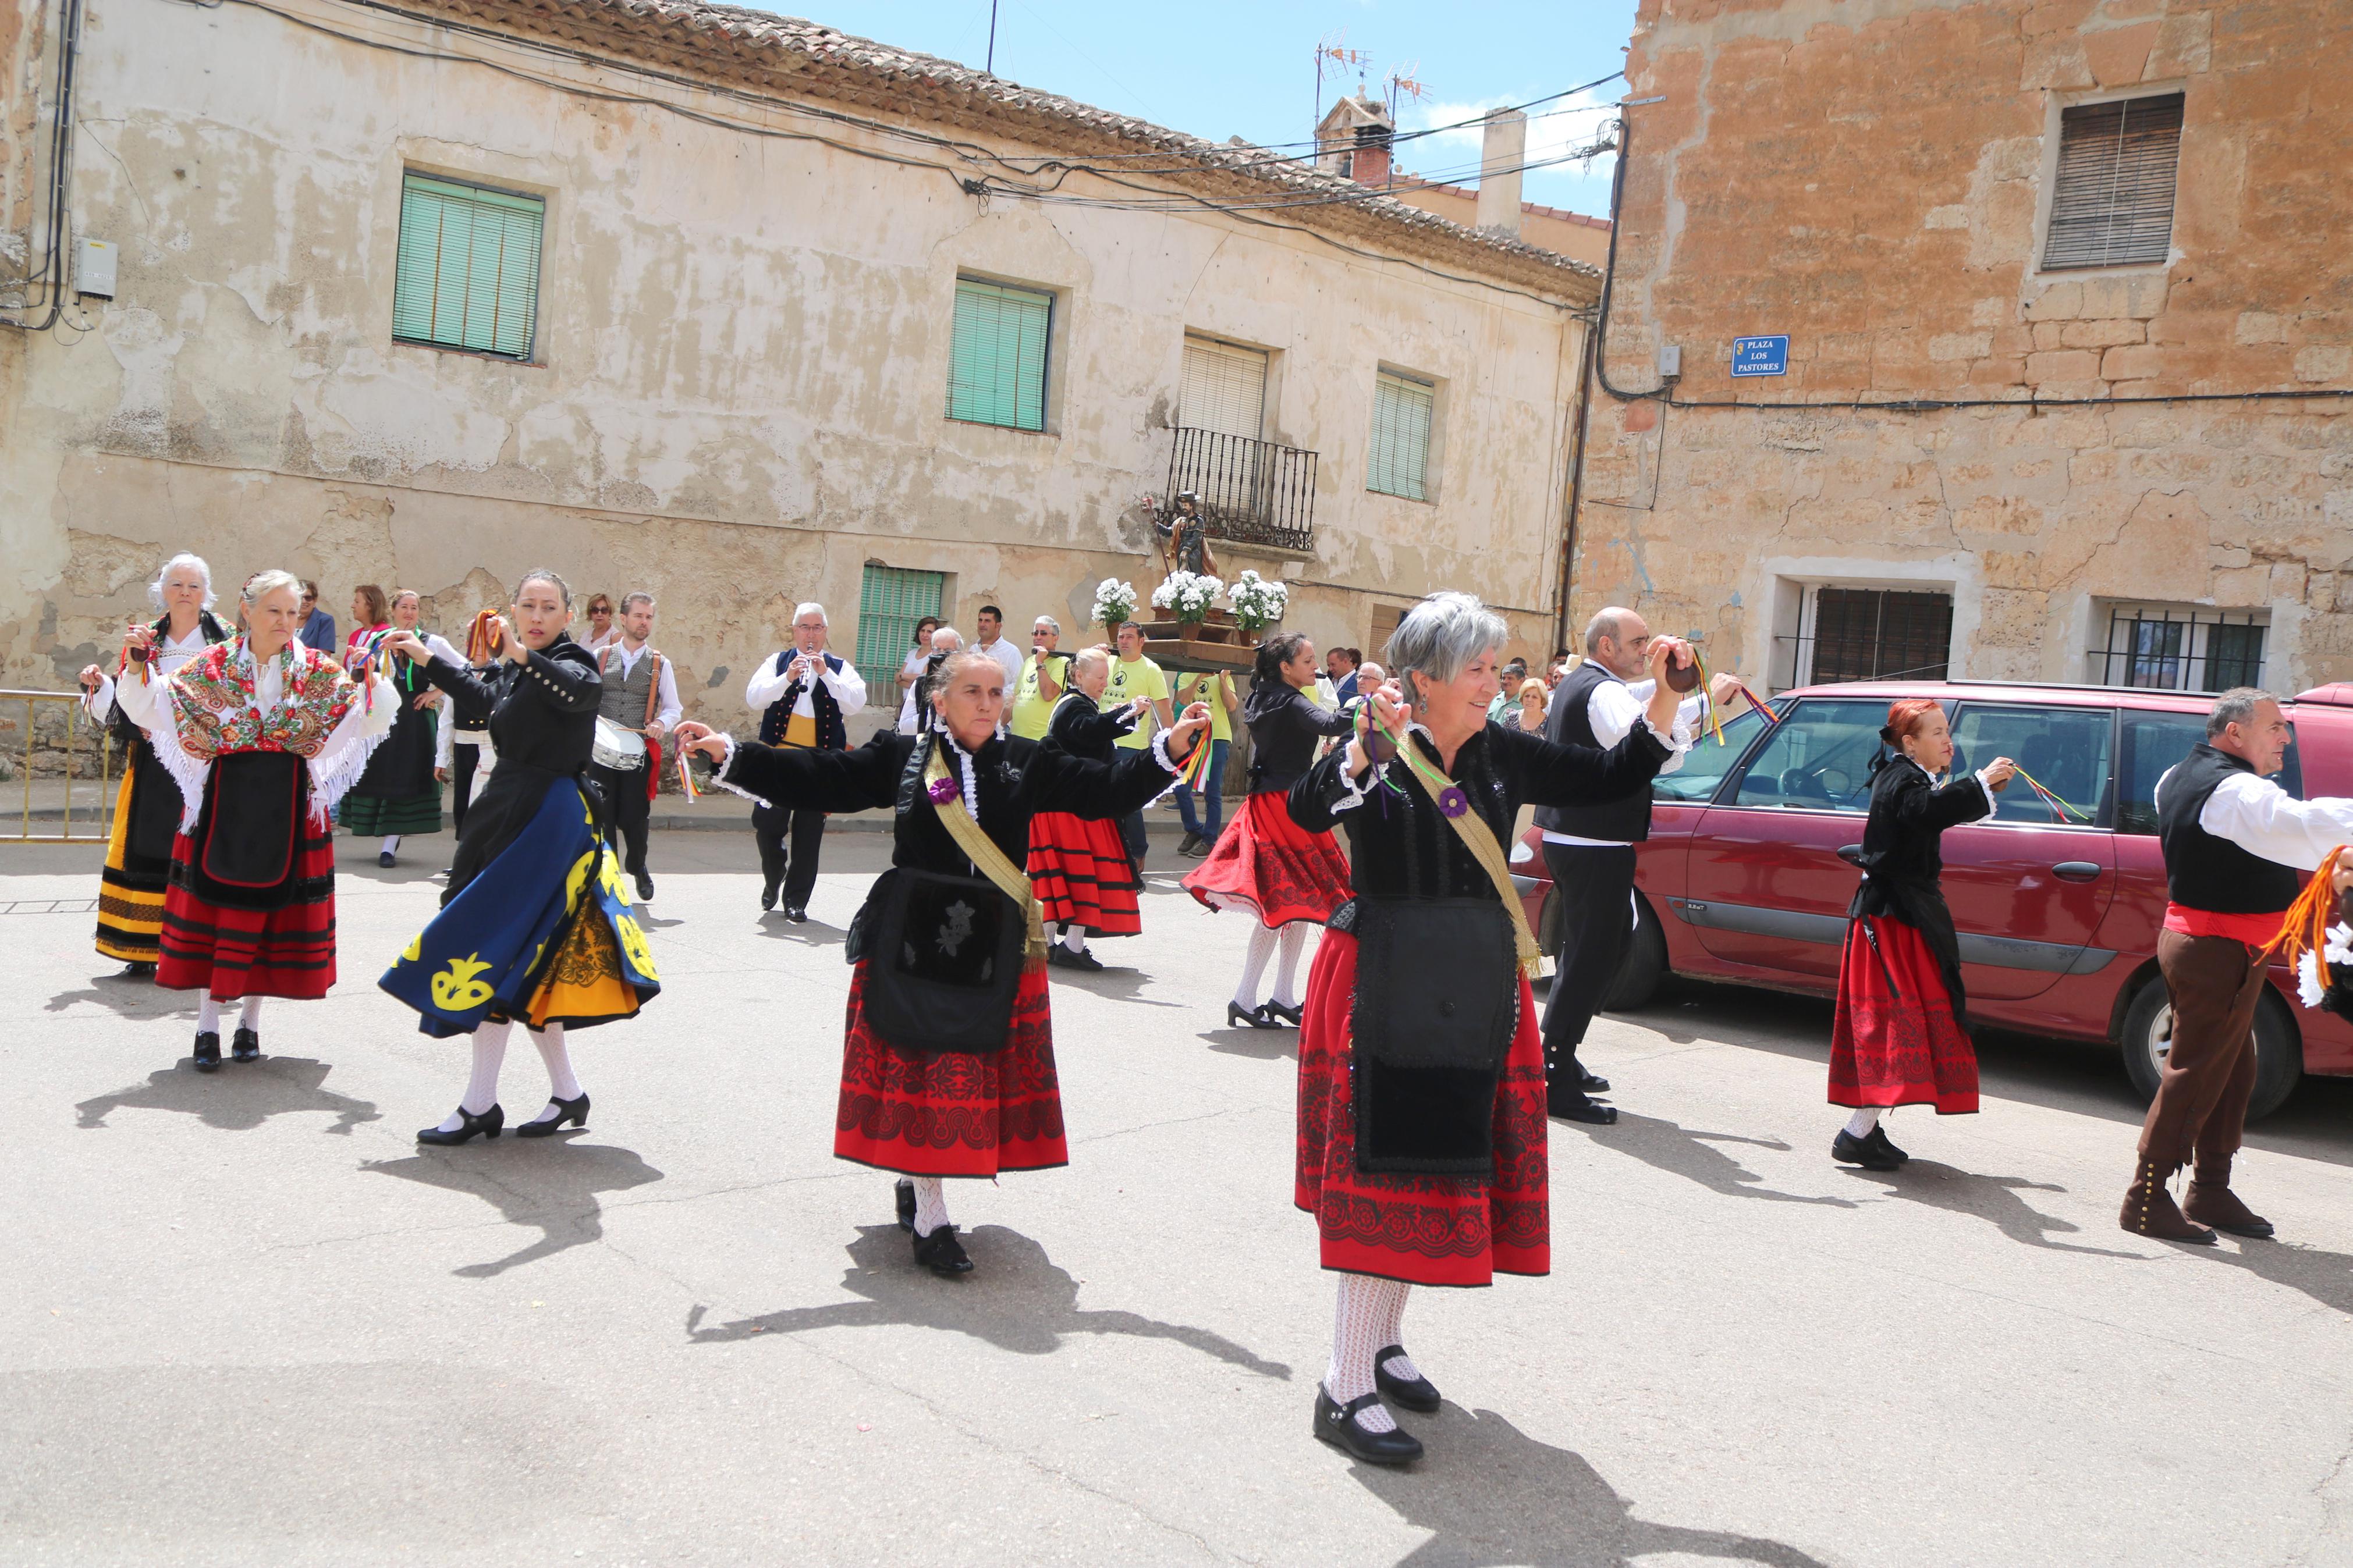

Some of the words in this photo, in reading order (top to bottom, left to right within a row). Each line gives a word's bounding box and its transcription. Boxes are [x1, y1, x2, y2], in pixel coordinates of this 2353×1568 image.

[1747, 340, 1773, 349] PLAZA
[1751, 352, 1767, 360] LOS
[1738, 363, 1779, 372] PASTORES
